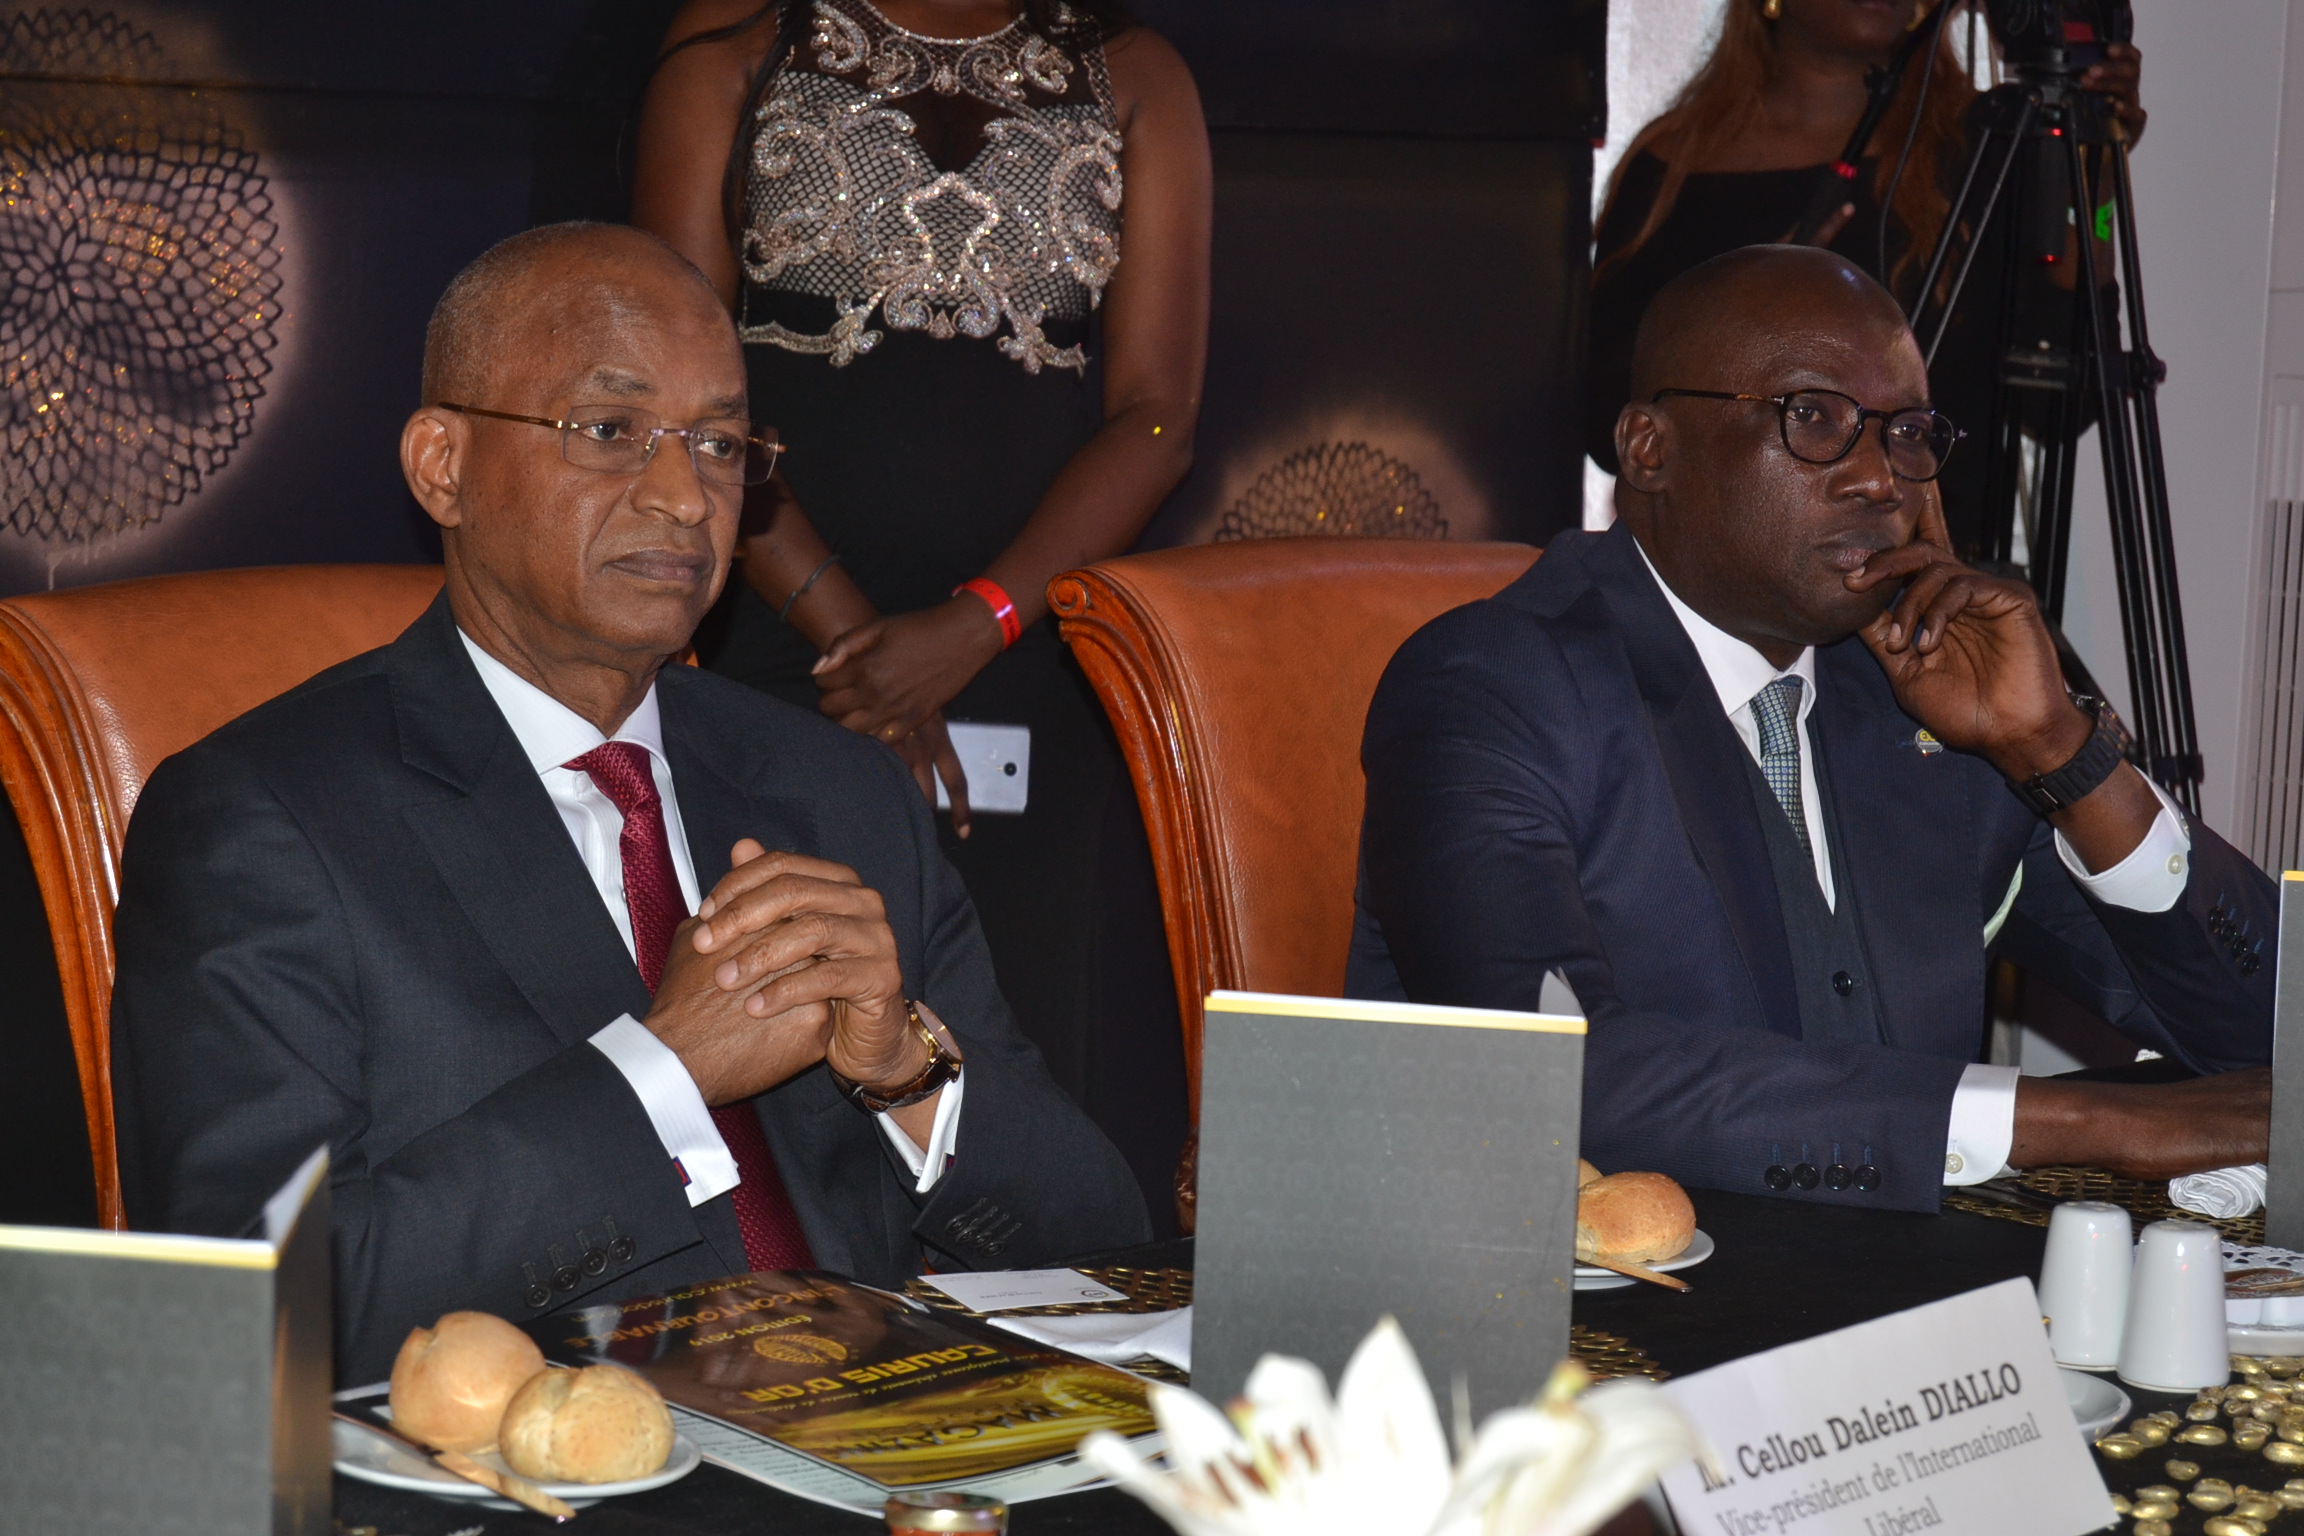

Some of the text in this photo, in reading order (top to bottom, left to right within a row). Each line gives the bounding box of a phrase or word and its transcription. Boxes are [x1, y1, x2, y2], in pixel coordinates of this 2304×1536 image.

[689, 1314, 813, 1348] ÉDITION 2019
[741, 1344, 998, 1403] CAURIS D'OR
[1737, 1433, 1828, 1479] Cellou
[1825, 1398, 1919, 1452] Dalein
[1919, 1362, 2021, 1422] DIALLO
[1715, 1411, 2042, 1536] Vice-président de l'International
